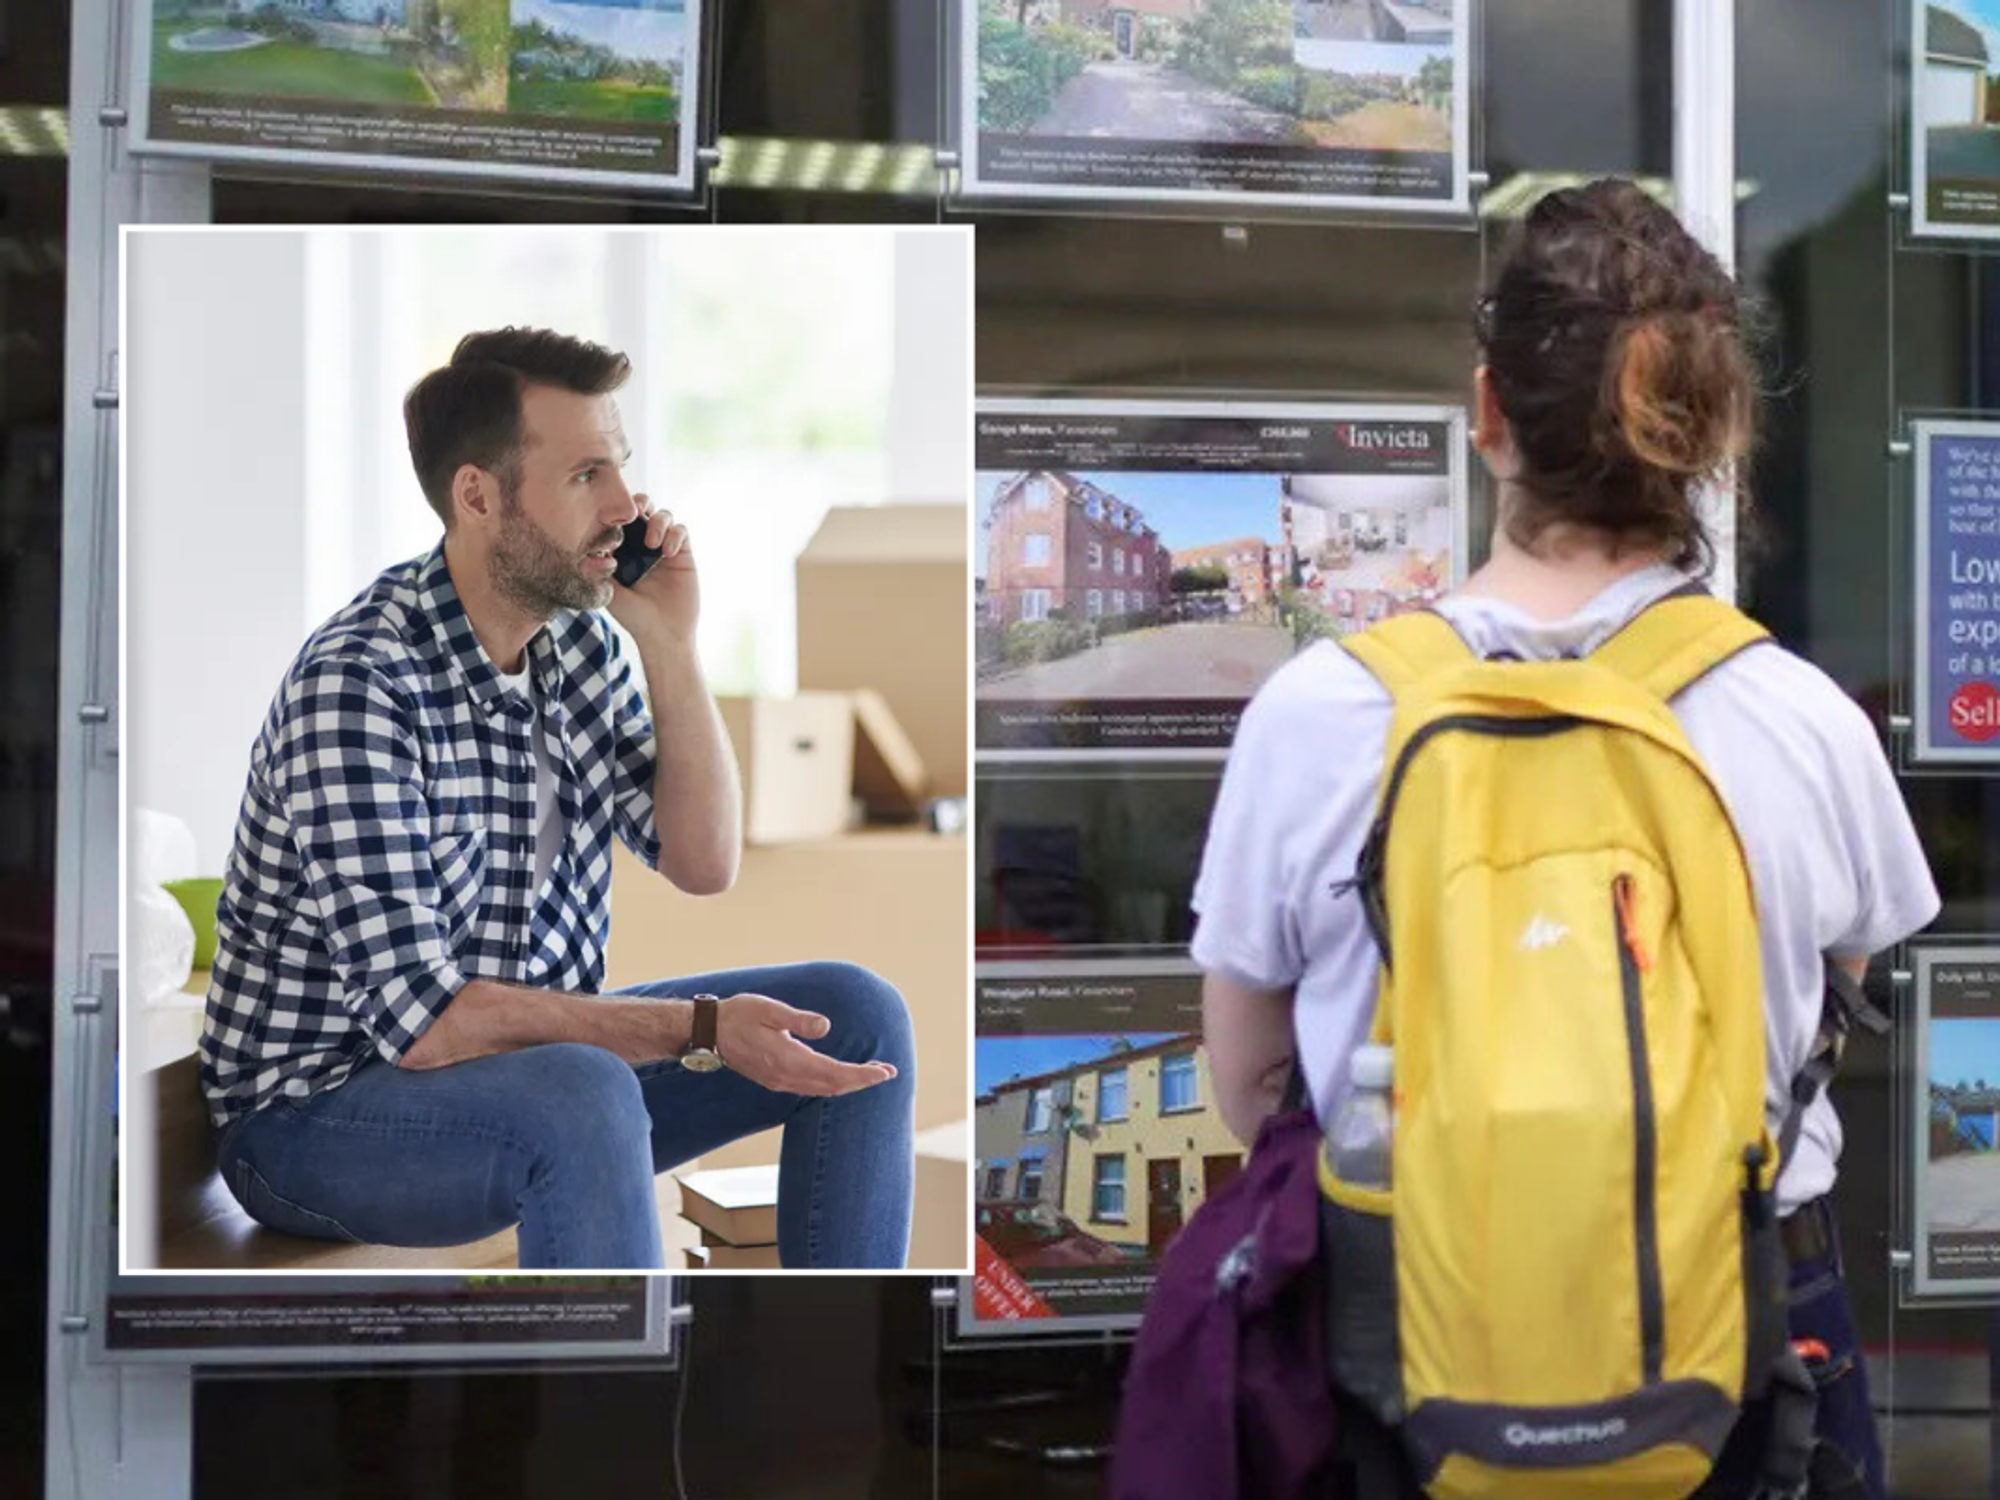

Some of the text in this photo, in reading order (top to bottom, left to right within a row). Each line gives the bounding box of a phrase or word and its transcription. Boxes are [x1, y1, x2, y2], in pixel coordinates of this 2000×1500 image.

[1350, 424, 1430, 448] Invicta
[1949, 592, 1988, 610] with
[1949, 620, 2000, 650] exp
[1949, 652, 1969, 674] of
